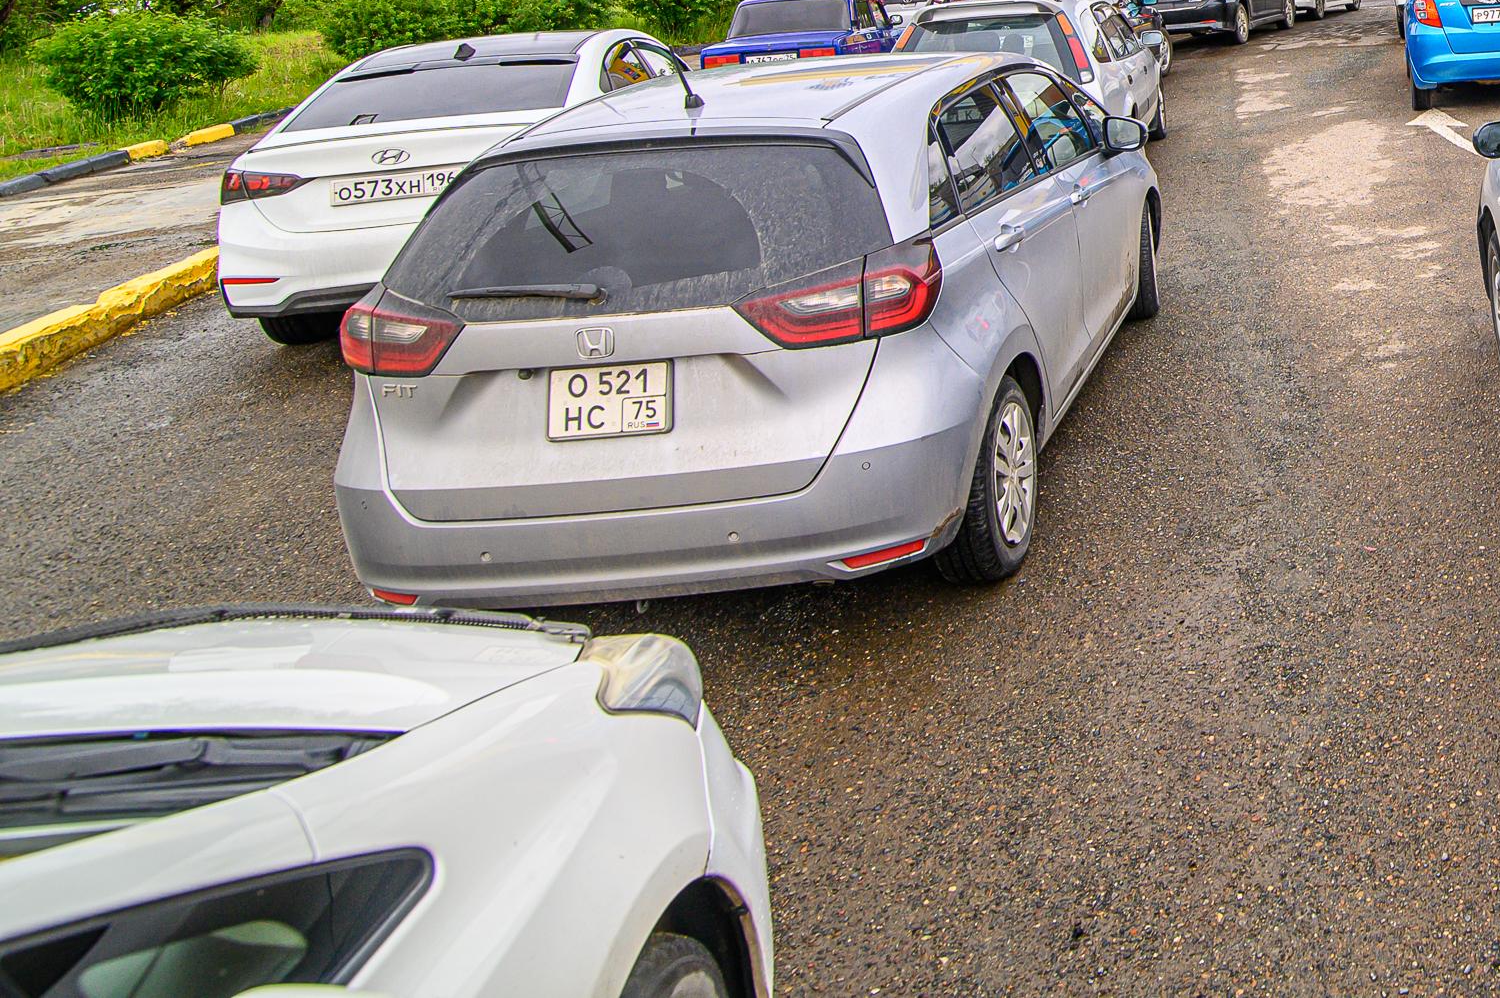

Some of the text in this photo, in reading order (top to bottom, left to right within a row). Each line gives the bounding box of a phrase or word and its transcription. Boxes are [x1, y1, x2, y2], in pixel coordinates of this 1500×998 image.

[338, 178, 421, 201] О573ХН
[382, 384, 418, 398] FIT
[567, 368, 648, 398] О 521
[564, 399, 657, 432] НС 75
[627, 421, 646, 429] RUS
